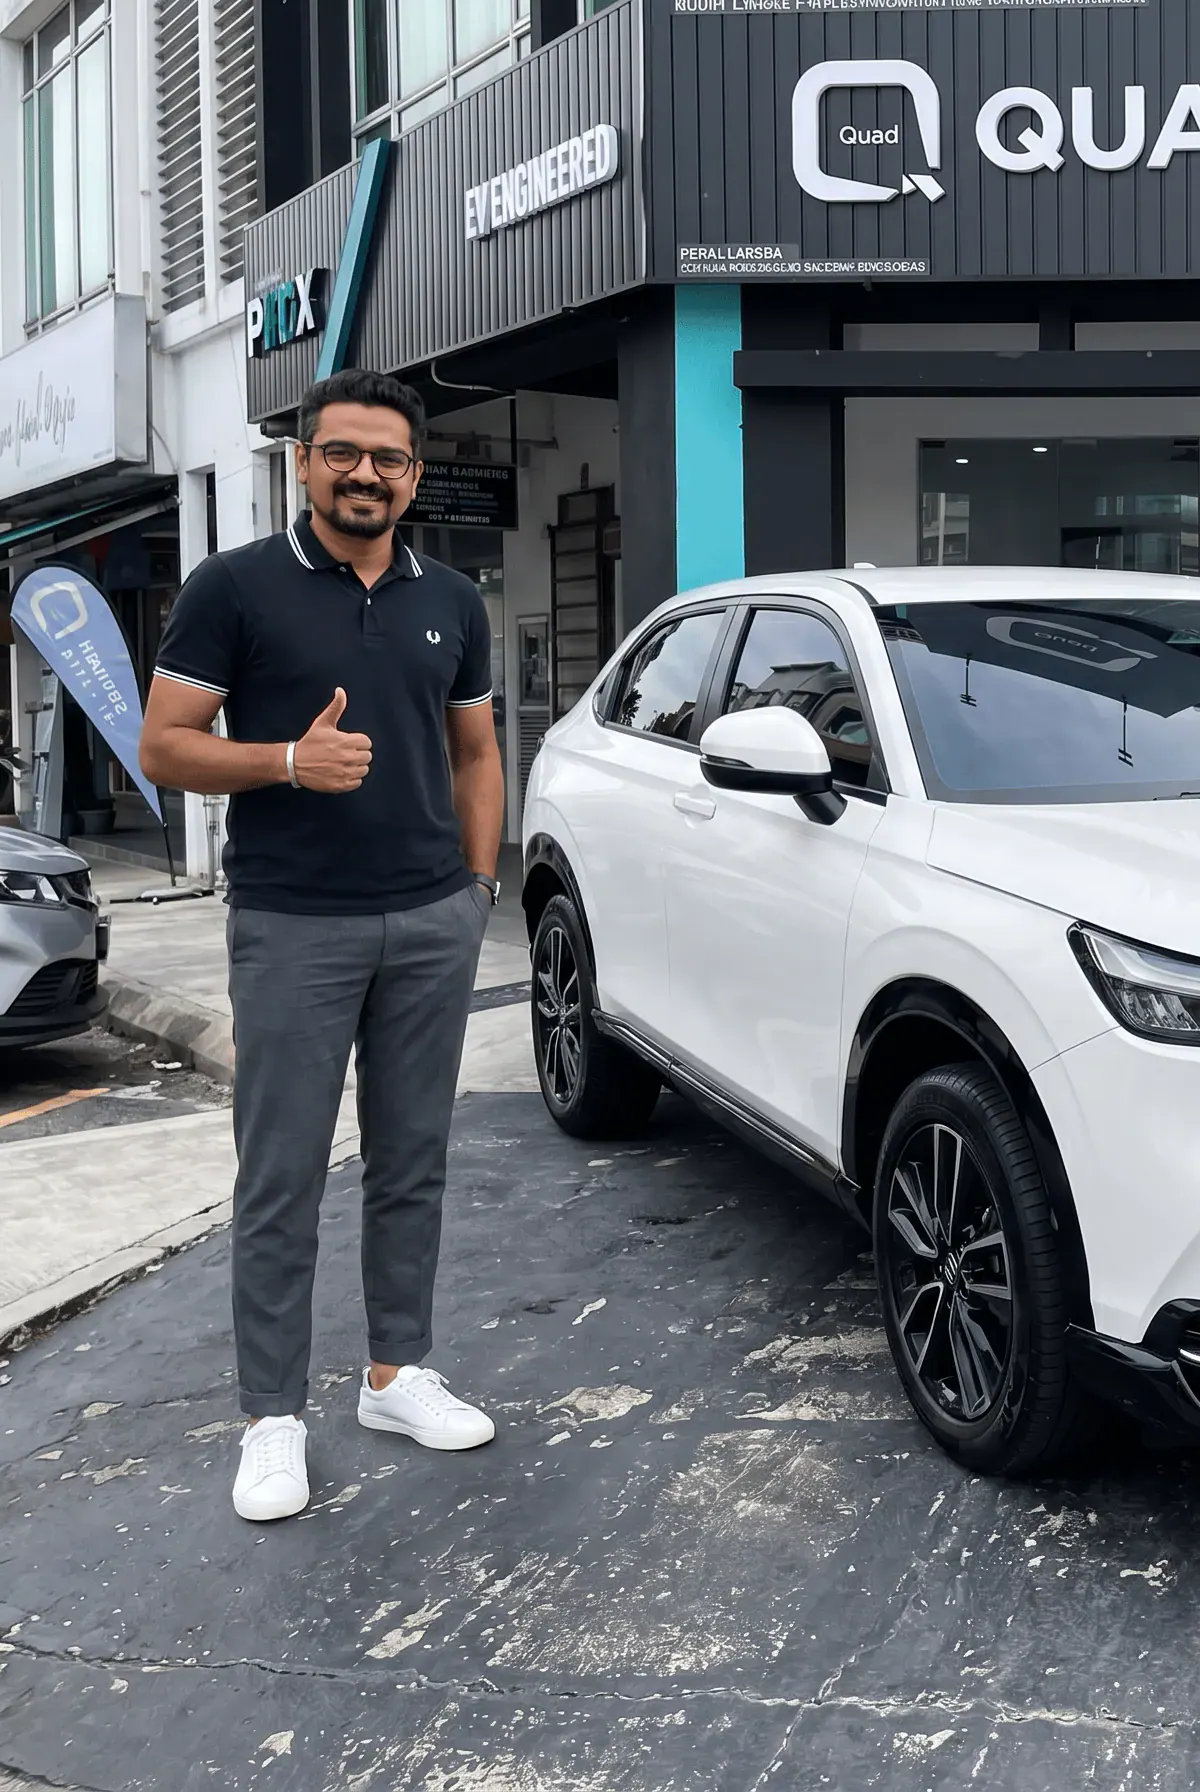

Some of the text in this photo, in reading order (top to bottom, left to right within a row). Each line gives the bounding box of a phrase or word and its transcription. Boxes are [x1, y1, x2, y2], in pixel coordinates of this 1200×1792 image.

[838, 125, 899, 146] Quad
[680, 247, 783, 260] PERAL LARSBA
